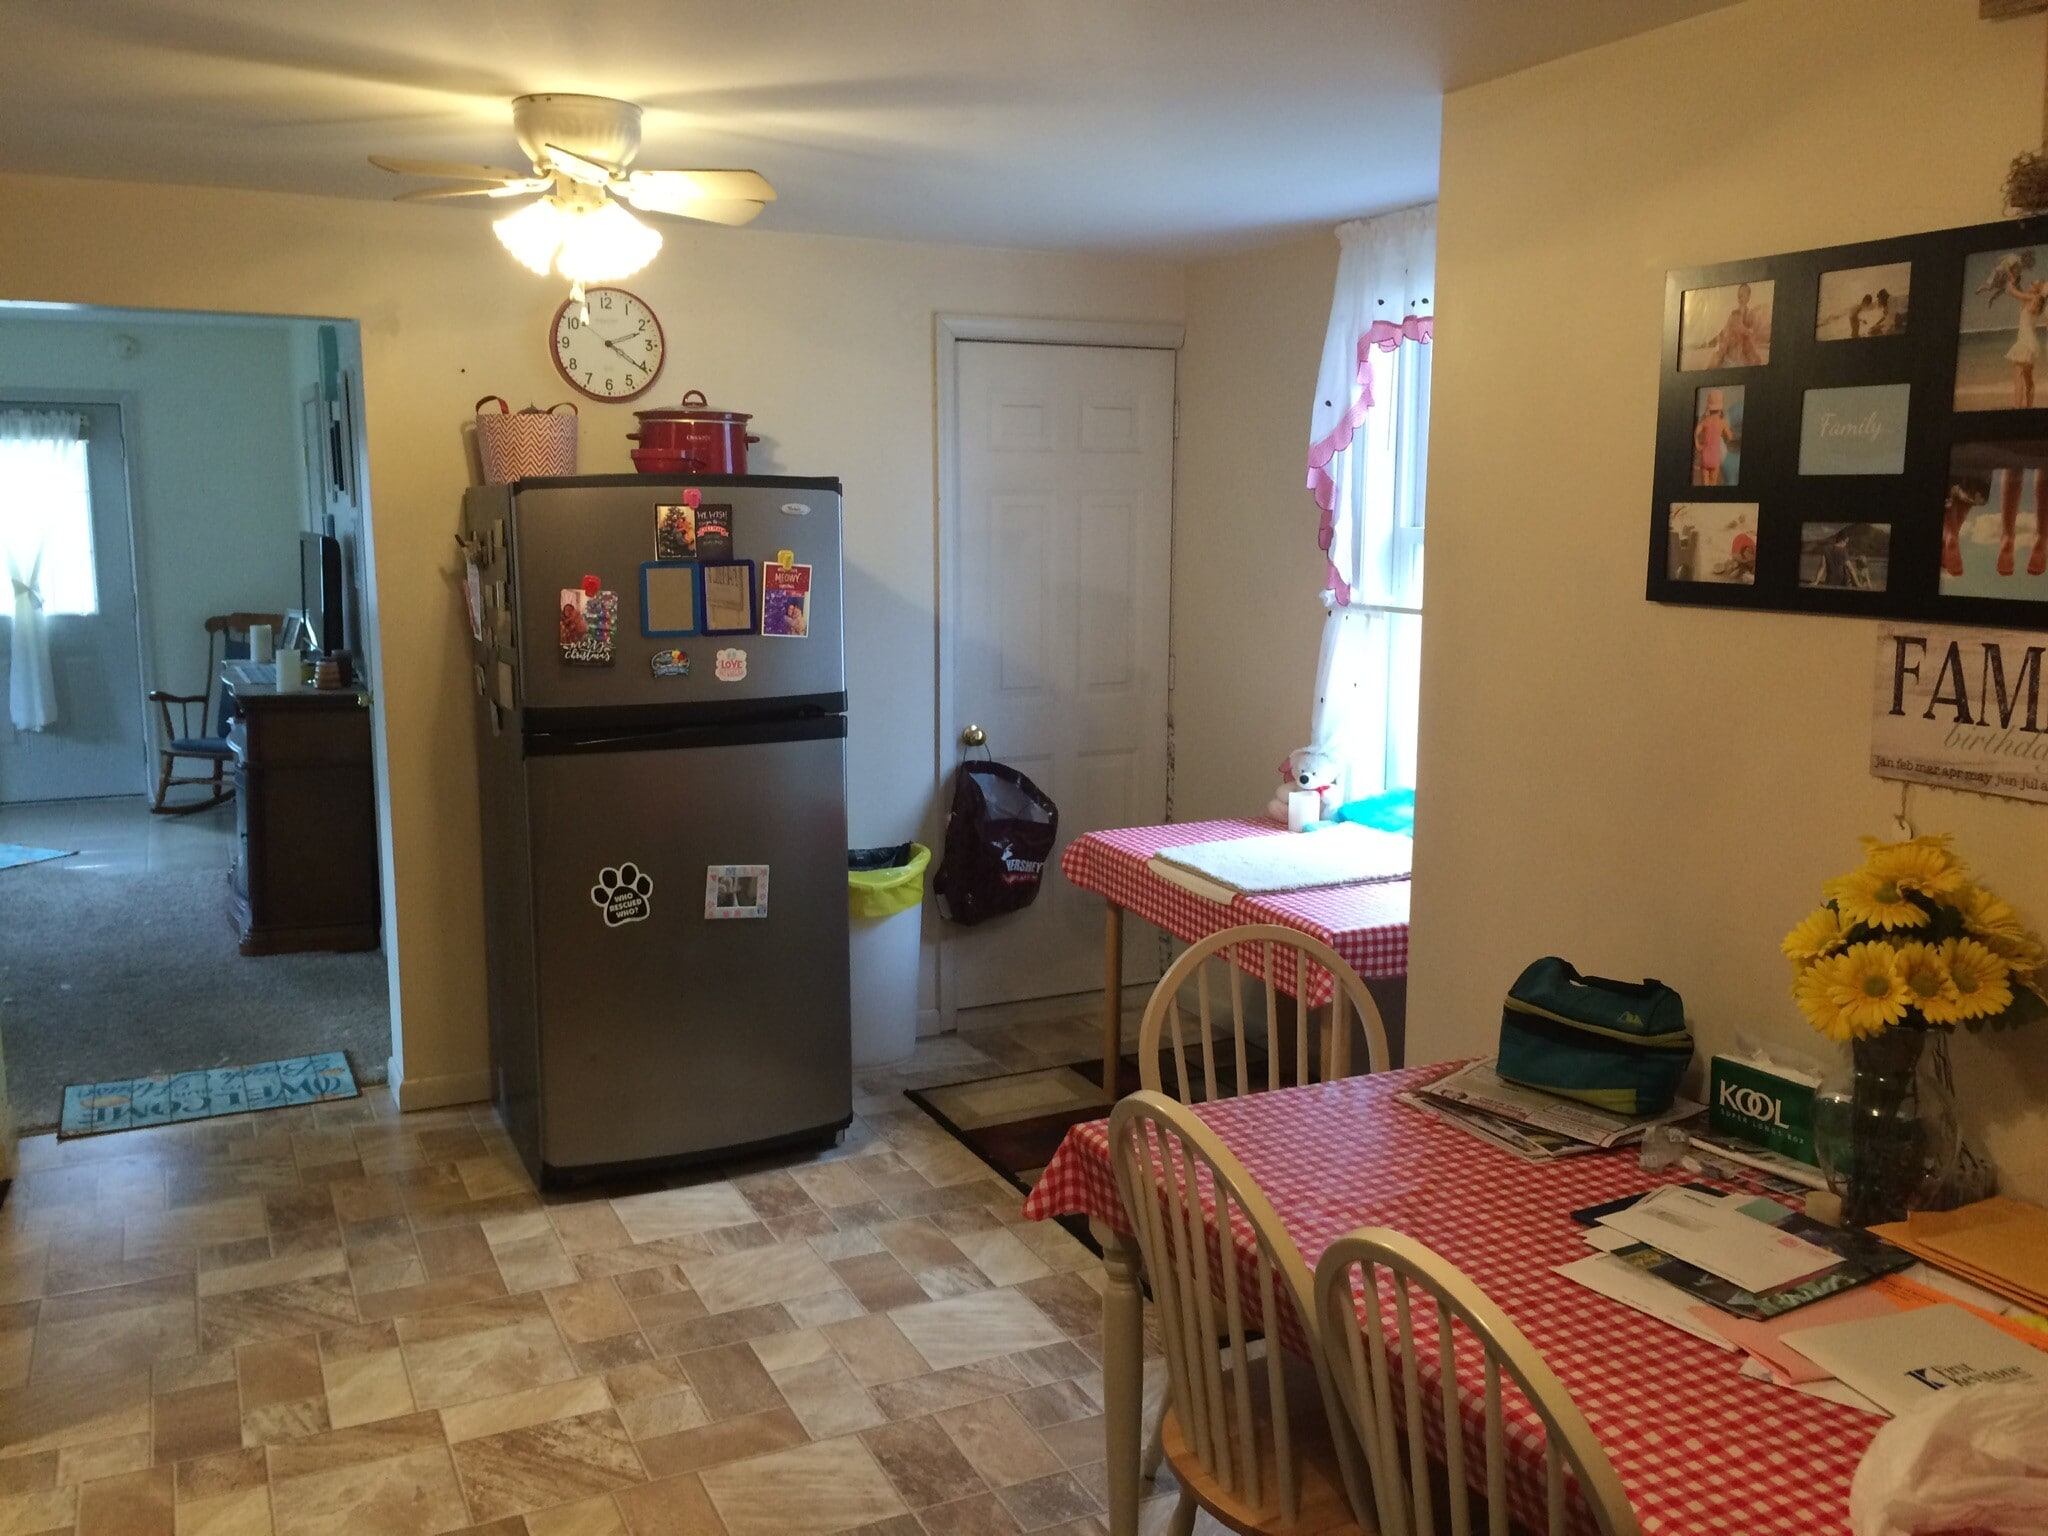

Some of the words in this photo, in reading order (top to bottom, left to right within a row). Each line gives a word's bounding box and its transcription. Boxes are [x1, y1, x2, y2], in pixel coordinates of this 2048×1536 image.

[600, 297, 612, 309] 12
[567, 317, 579, 330] 10
[638, 319, 646, 331] 2
[562, 336, 570, 349] 9
[645, 339, 653, 352] 3
[569, 358, 577, 370] 8
[640, 360, 647, 374] 4
[585, 372, 593, 385] 7
[605, 379, 613, 391] 6
[625, 374, 633, 387] 5
[1819, 409, 1882, 441] Family
[721, 660, 743, 669] LOVE
[1889, 636, 2048, 734] FAM
[1943, 724, 2048, 766] birthda
[1896, 758, 1914, 772] feb
[1915, 763, 1939, 775] mar
[1942, 765, 1964, 780] apr
[1965, 771, 1993, 786] may
[1995, 773, 2018, 788] jun
[2020, 776, 2038, 791] jul
[614, 893, 634, 902] WHO
[609, 898, 642, 912] RESCUED
[615, 907, 639, 919] WHO?
[1720, 1079, 1789, 1129] KOOL
[1720, 1108, 1748, 1124] SUPER
[1752, 1120, 1782, 1137] LONGS
[1787, 1134, 1804, 1145] BOX
